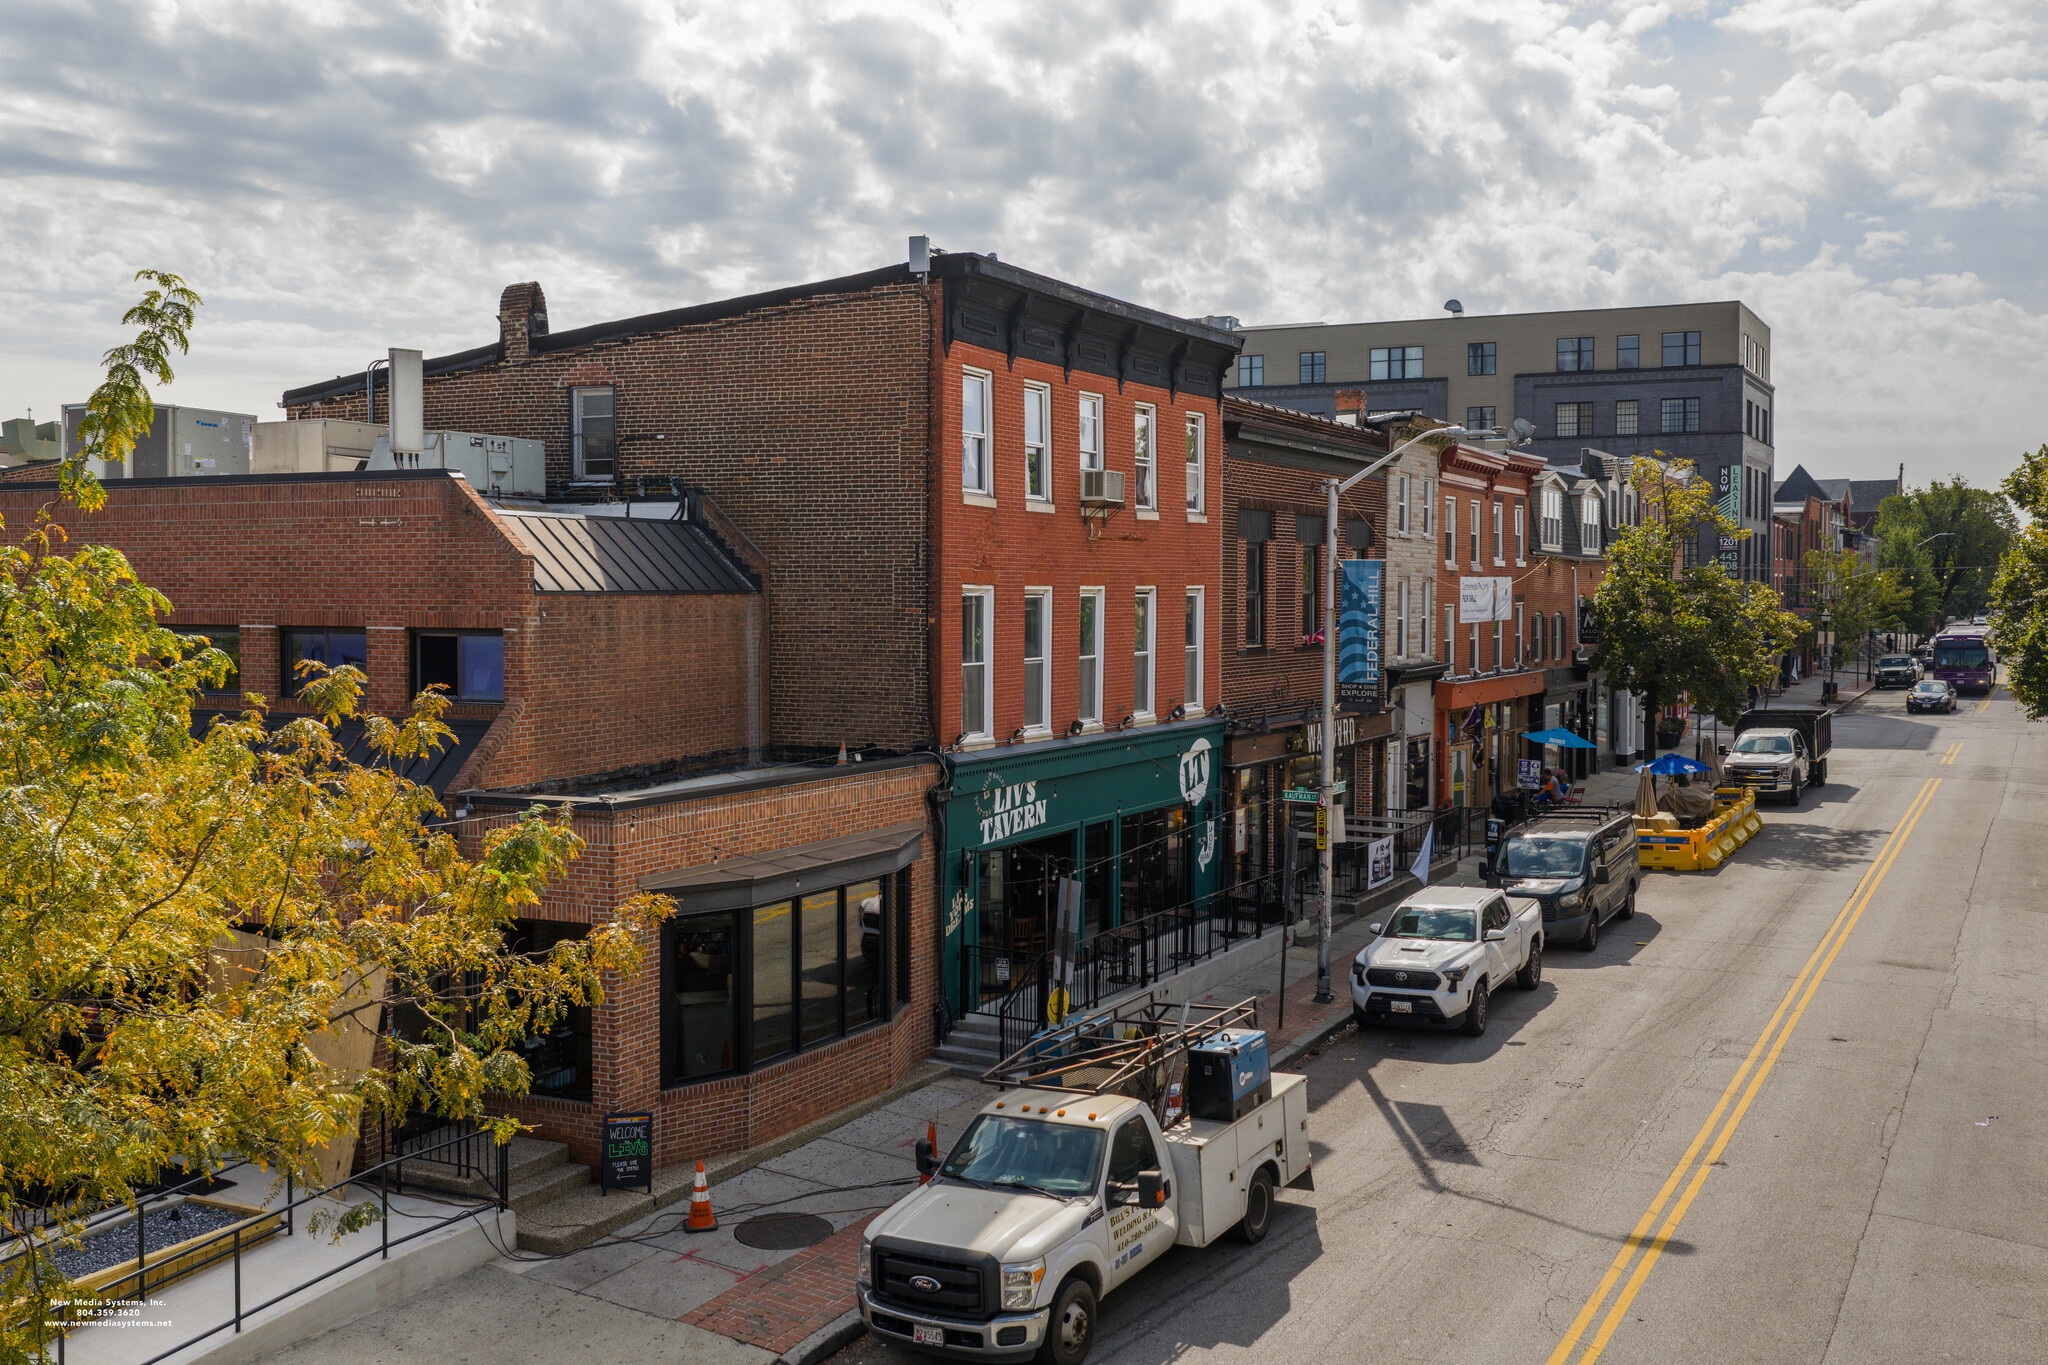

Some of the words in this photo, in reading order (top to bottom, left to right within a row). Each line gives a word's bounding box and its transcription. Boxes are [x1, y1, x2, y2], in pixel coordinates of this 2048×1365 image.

[1720, 467, 1729, 493] NOW
[1719, 538, 1738, 546] 1201
[1720, 552, 1738, 561] 443
[1368, 570, 1380, 604] HILL
[1367, 608, 1379, 681] FEDERAL
[993, 780, 1037, 814] LIV'S
[1284, 792, 1311, 801] KAUFMAN
[980, 799, 1047, 845] TAVERN
[610, 1125, 647, 1140] WELCOME
[608, 1138, 649, 1158] LIV'S
[1110, 1208, 1130, 1227] BILL'S
[1113, 1216, 1142, 1240] WELDING
[1142, 1211, 1148, 1221] &
[915, 1279, 932, 1290] Ford
